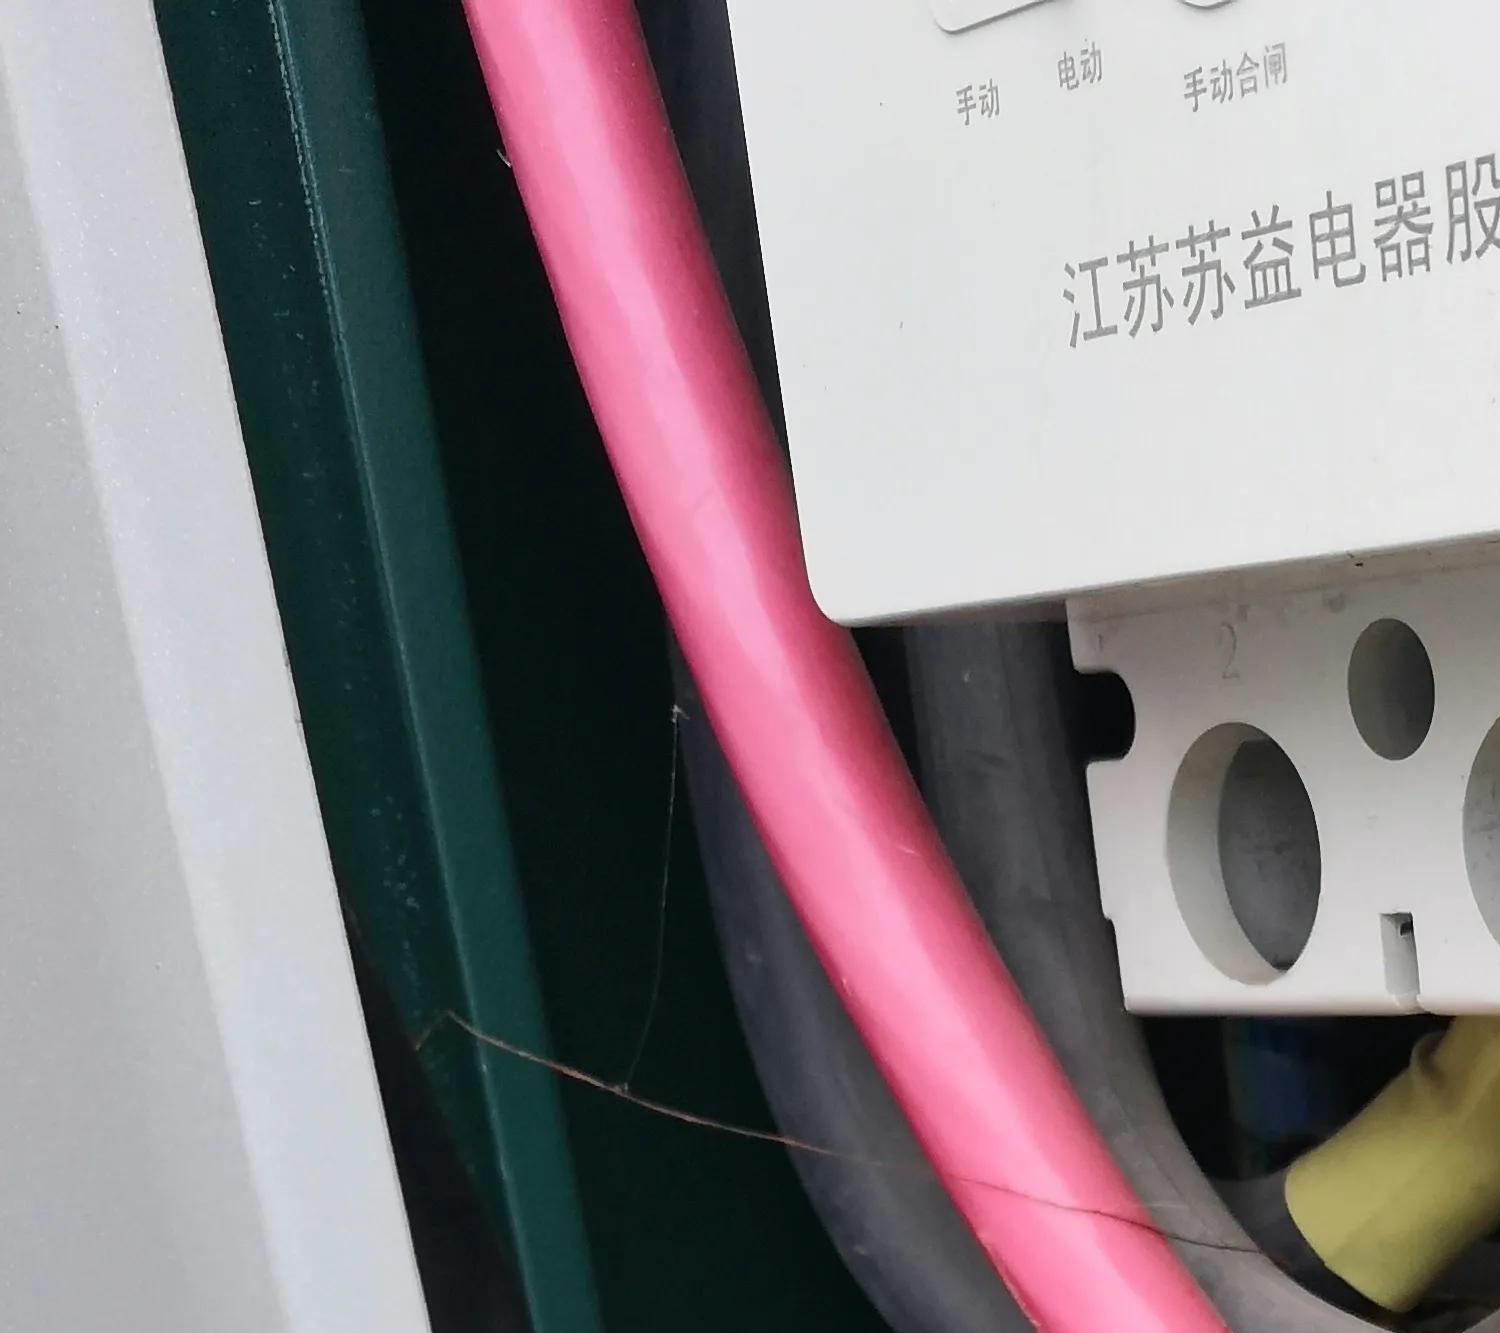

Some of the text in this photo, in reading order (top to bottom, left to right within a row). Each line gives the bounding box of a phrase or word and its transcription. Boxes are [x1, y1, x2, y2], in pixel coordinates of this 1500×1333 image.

[1057, 40, 1102, 91] 电动
[1184, 42, 1288, 112] 手动合闸
[956, 78, 1000, 126] 手动
